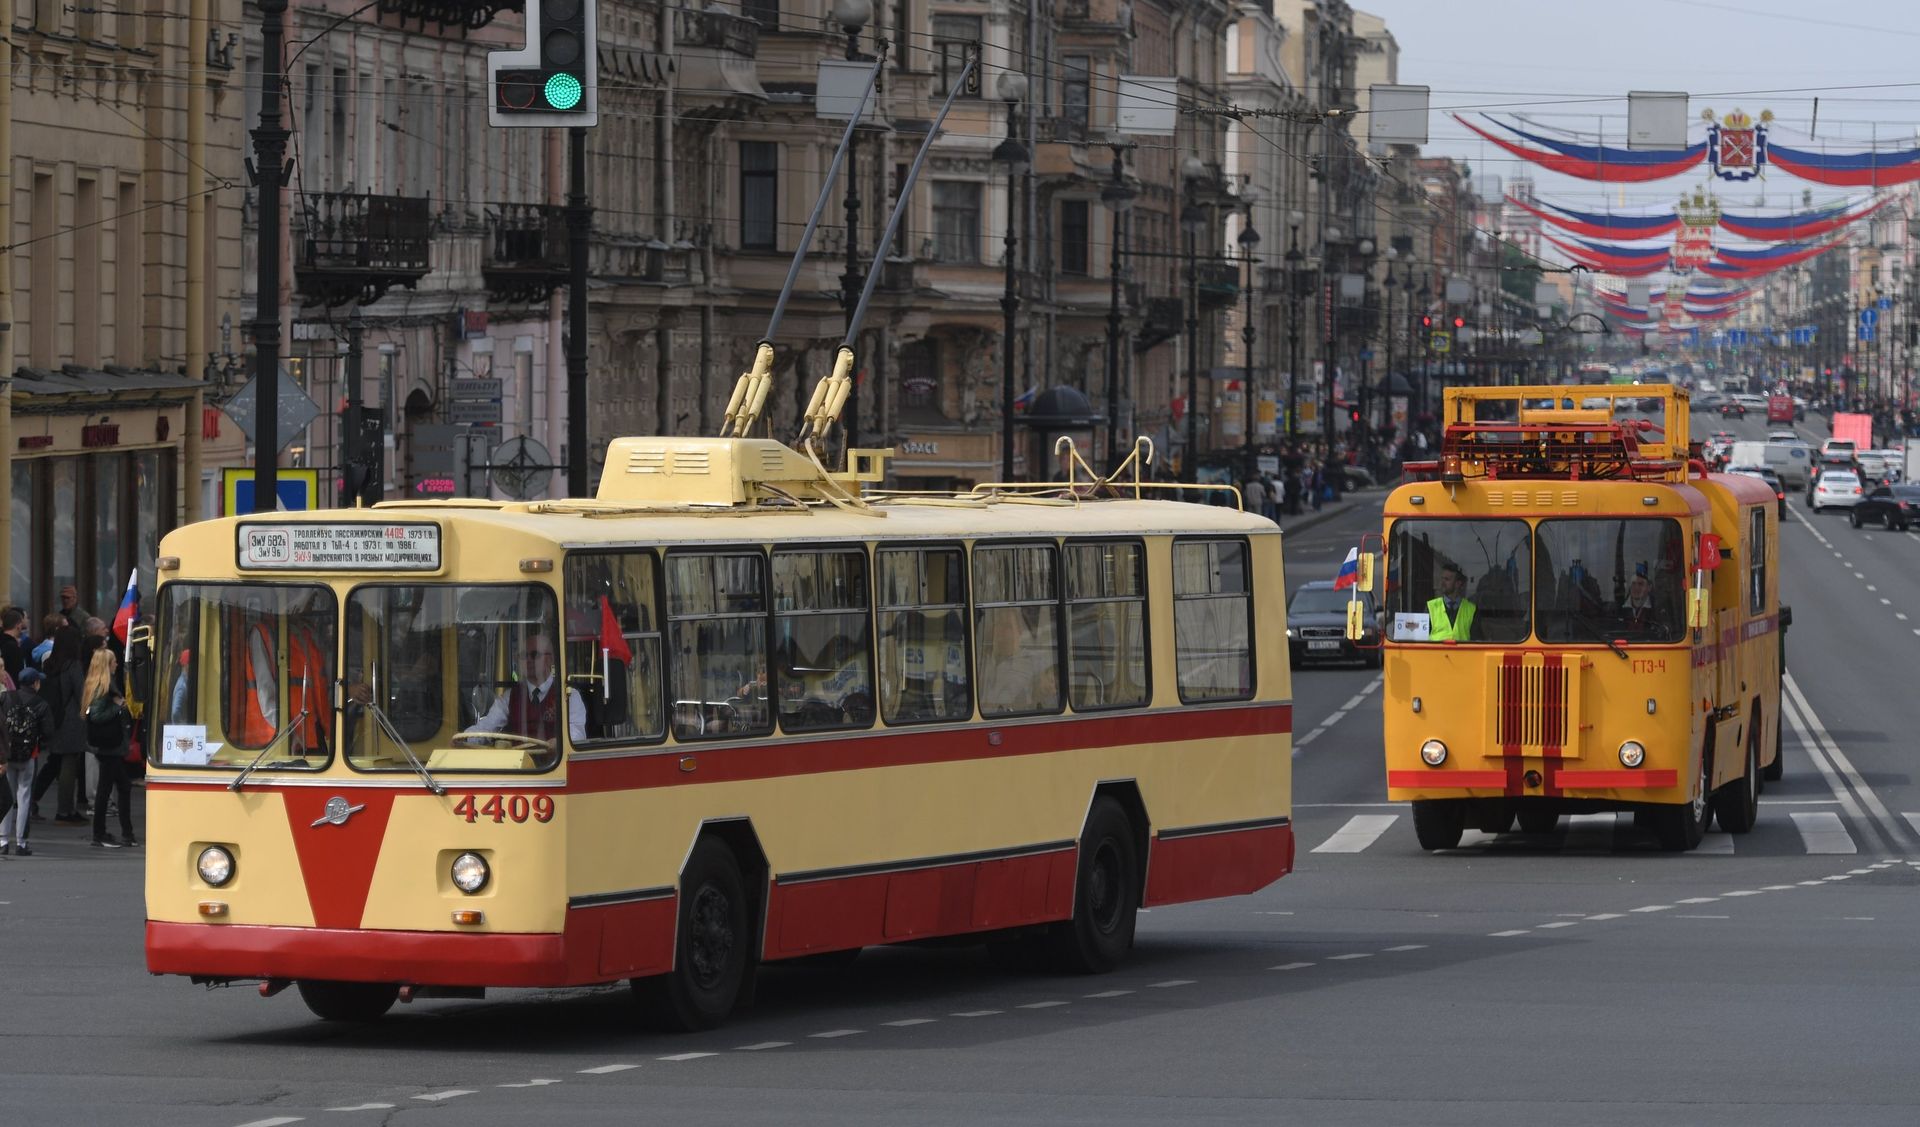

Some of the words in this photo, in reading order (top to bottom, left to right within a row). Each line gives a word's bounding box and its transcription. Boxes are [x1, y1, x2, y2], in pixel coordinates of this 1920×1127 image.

[902, 441, 939, 455] SPACE
[294, 528, 332, 538] ТРОЛЛЕЙБУС
[335, 528, 383, 538] ПАССАЖИРСКИЙ
[294, 541, 320, 550] РАБОТАЛ
[312, 553, 353, 563] ВЫПУСКАЮТСЯ
[360, 553, 383, 563] РАЗНЫХ
[197, 741, 203, 751] 5
[453, 794, 555, 824] 4409
